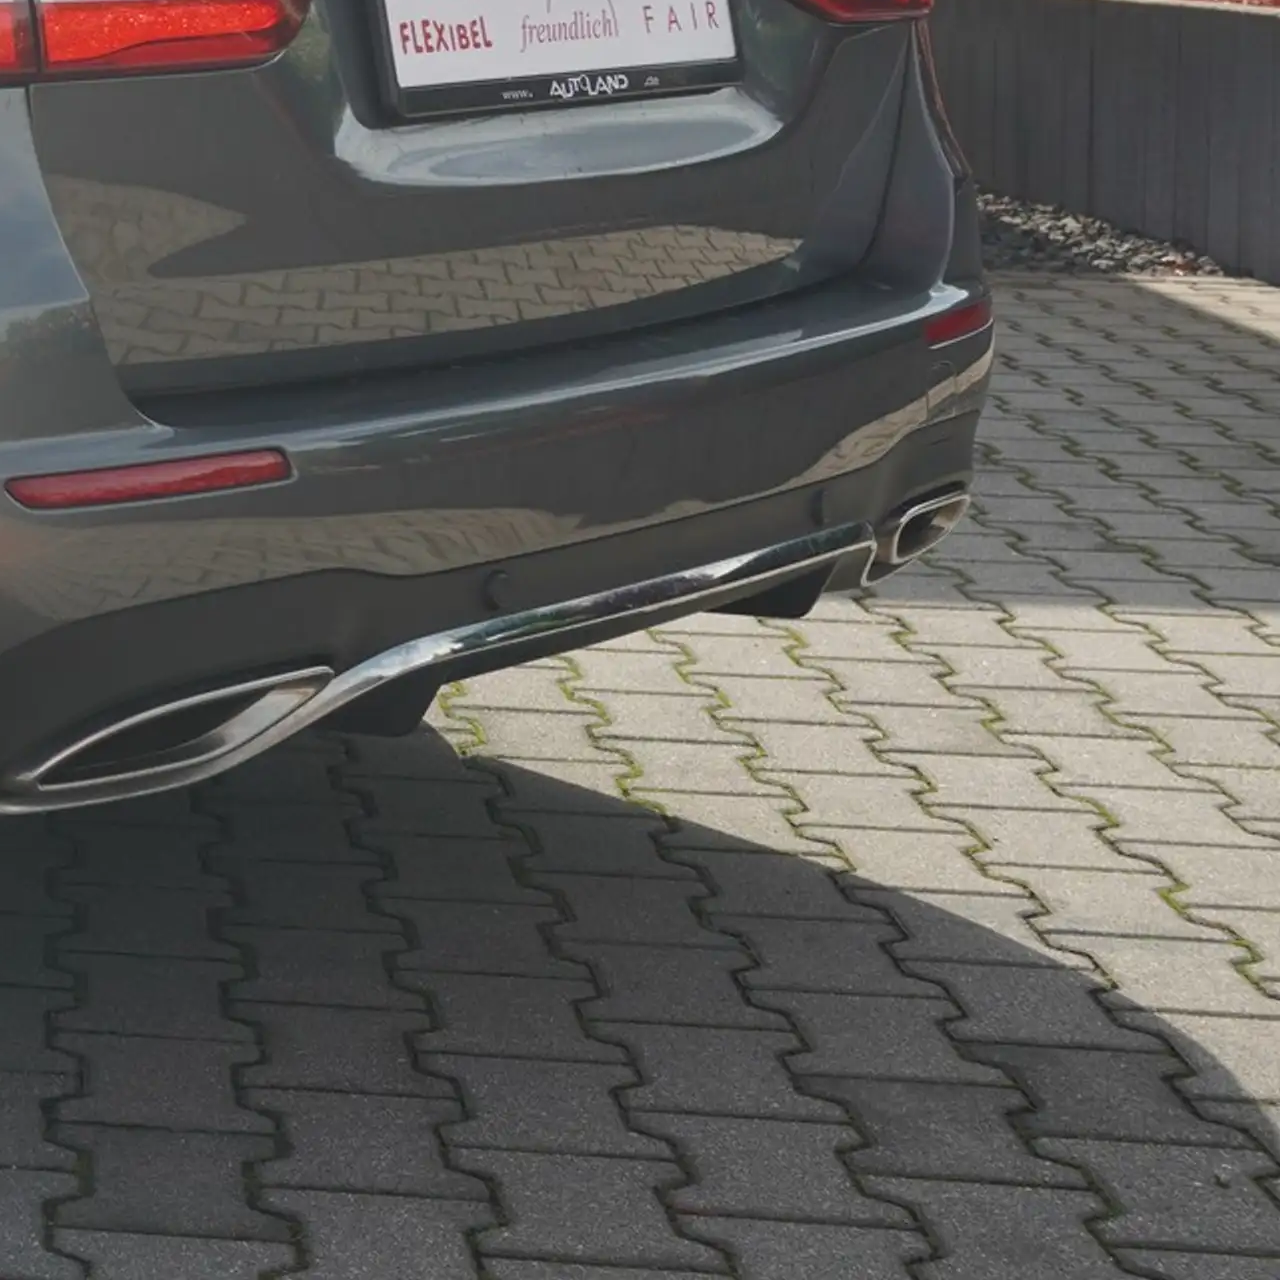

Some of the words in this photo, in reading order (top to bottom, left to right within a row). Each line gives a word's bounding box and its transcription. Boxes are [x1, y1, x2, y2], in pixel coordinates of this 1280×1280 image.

[398, 16, 494, 55] FLEXIBEL
[519, 8, 613, 53] freundlich
[642, 0, 720, 35] FAIR
[549, 74, 629, 100] AUTOLAND
